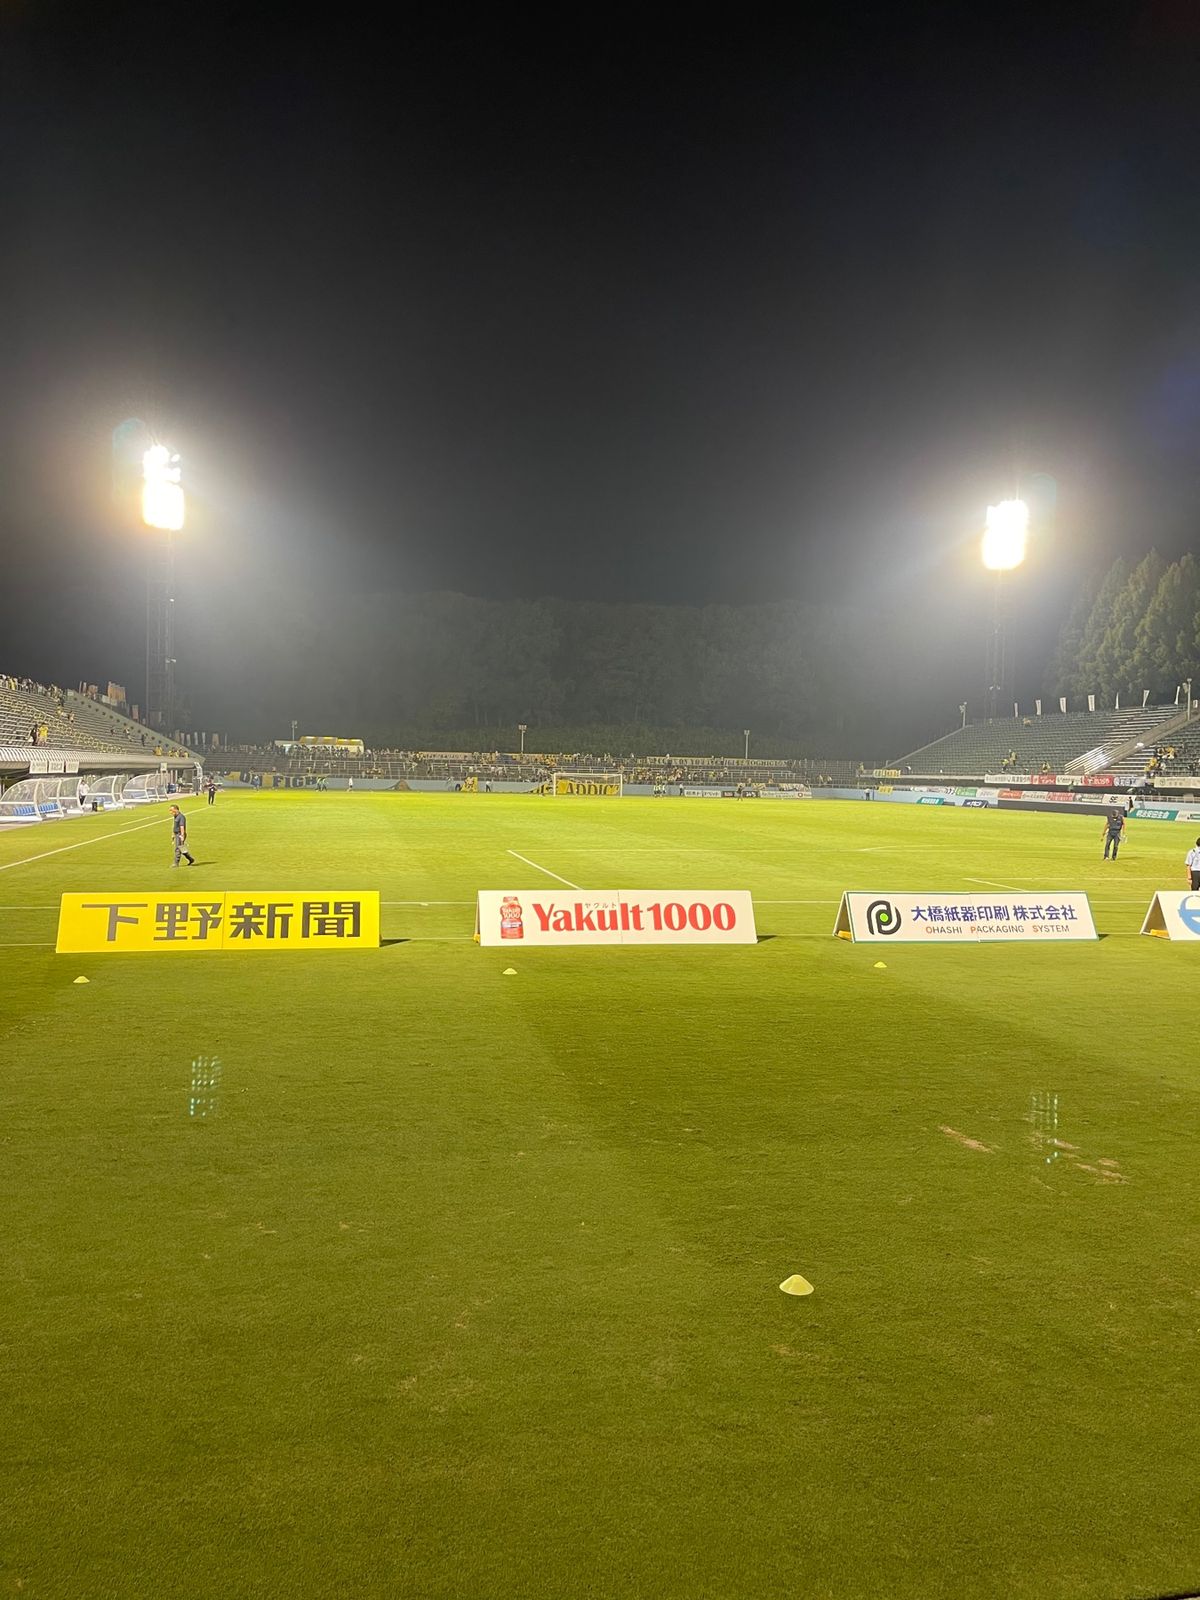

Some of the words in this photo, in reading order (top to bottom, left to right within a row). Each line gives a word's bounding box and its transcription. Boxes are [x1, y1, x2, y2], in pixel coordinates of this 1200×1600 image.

[81, 901, 361, 942] 下野新聞
[910, 904, 1010, 922] 大橋紙器印刷
[1013, 903, 1078, 921] 株式会社
[926, 924, 963, 934] OHASHI
[970, 924, 1025, 934] PACKAGING
[1033, 923, 1070, 933] SYSTEM
